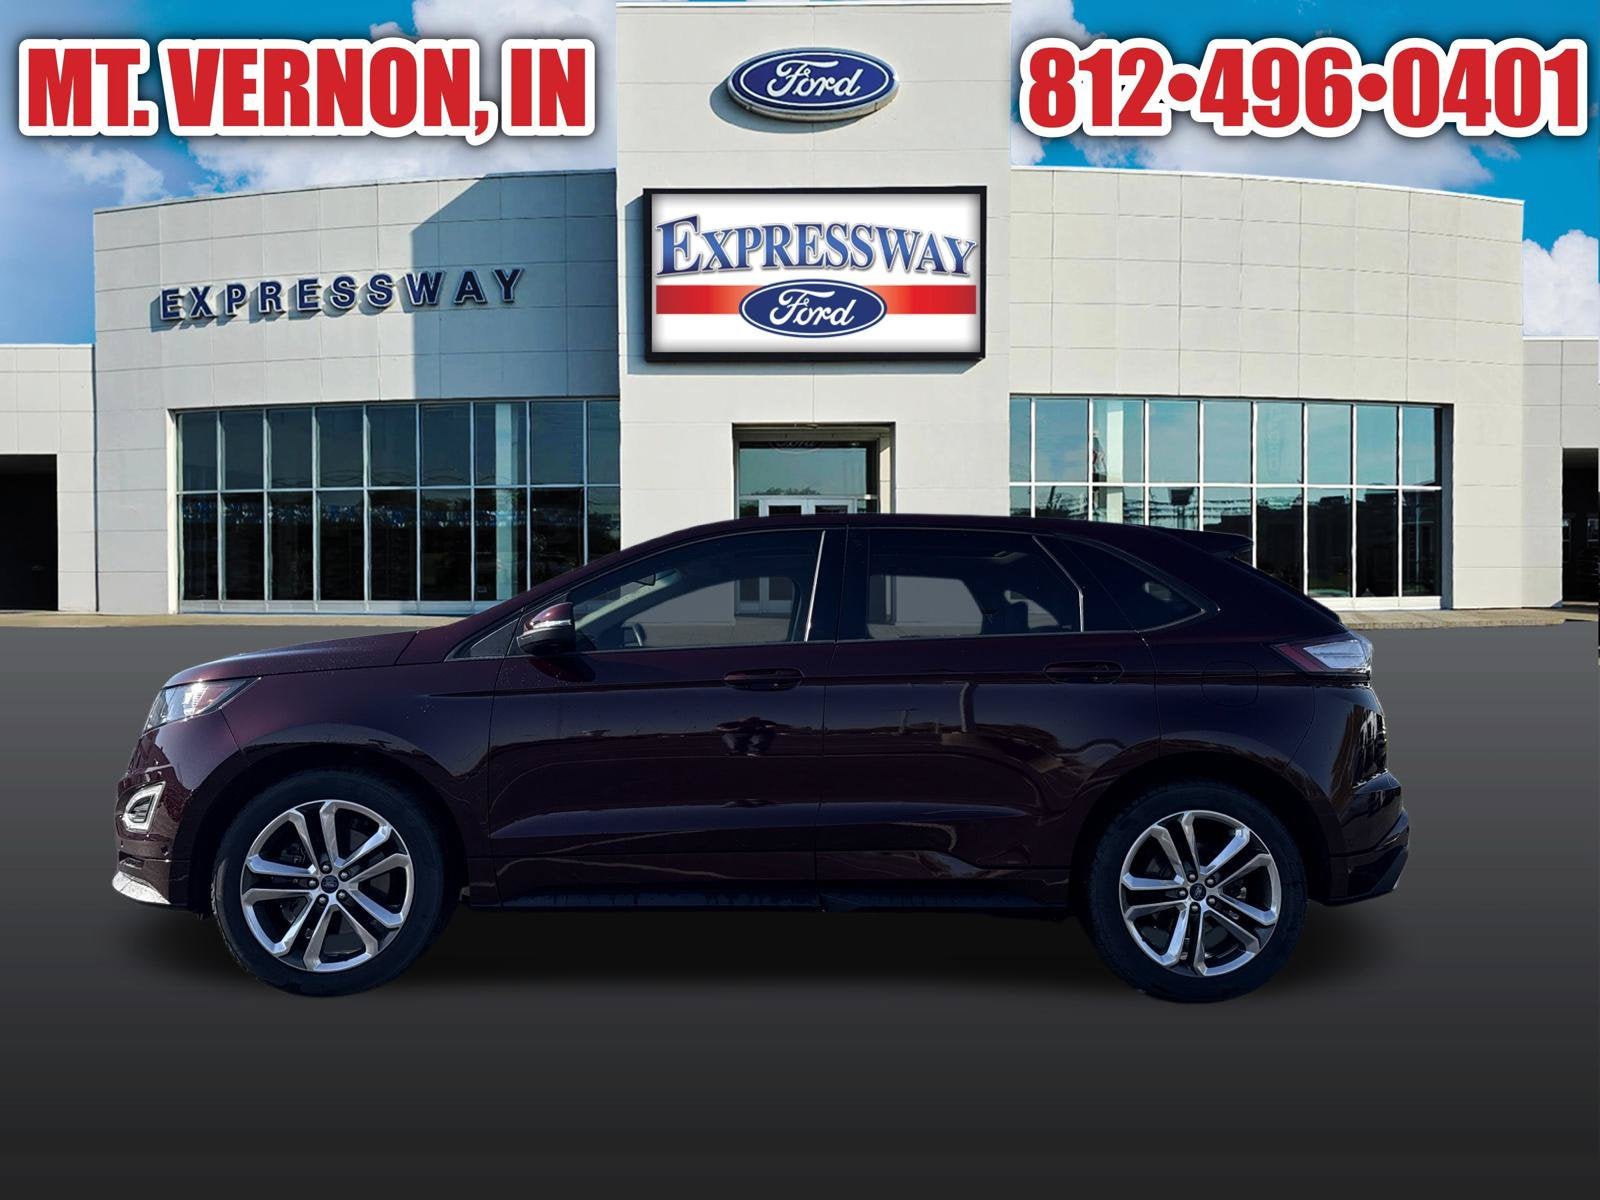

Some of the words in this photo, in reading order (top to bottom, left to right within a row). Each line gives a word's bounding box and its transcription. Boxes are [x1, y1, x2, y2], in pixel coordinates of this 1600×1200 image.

[766, 59, 864, 98] Ford
[655, 214, 977, 278] EXPRESSWAY
[159, 268, 525, 322] EXPRESSWAY
[769, 288, 857, 327] Ford
